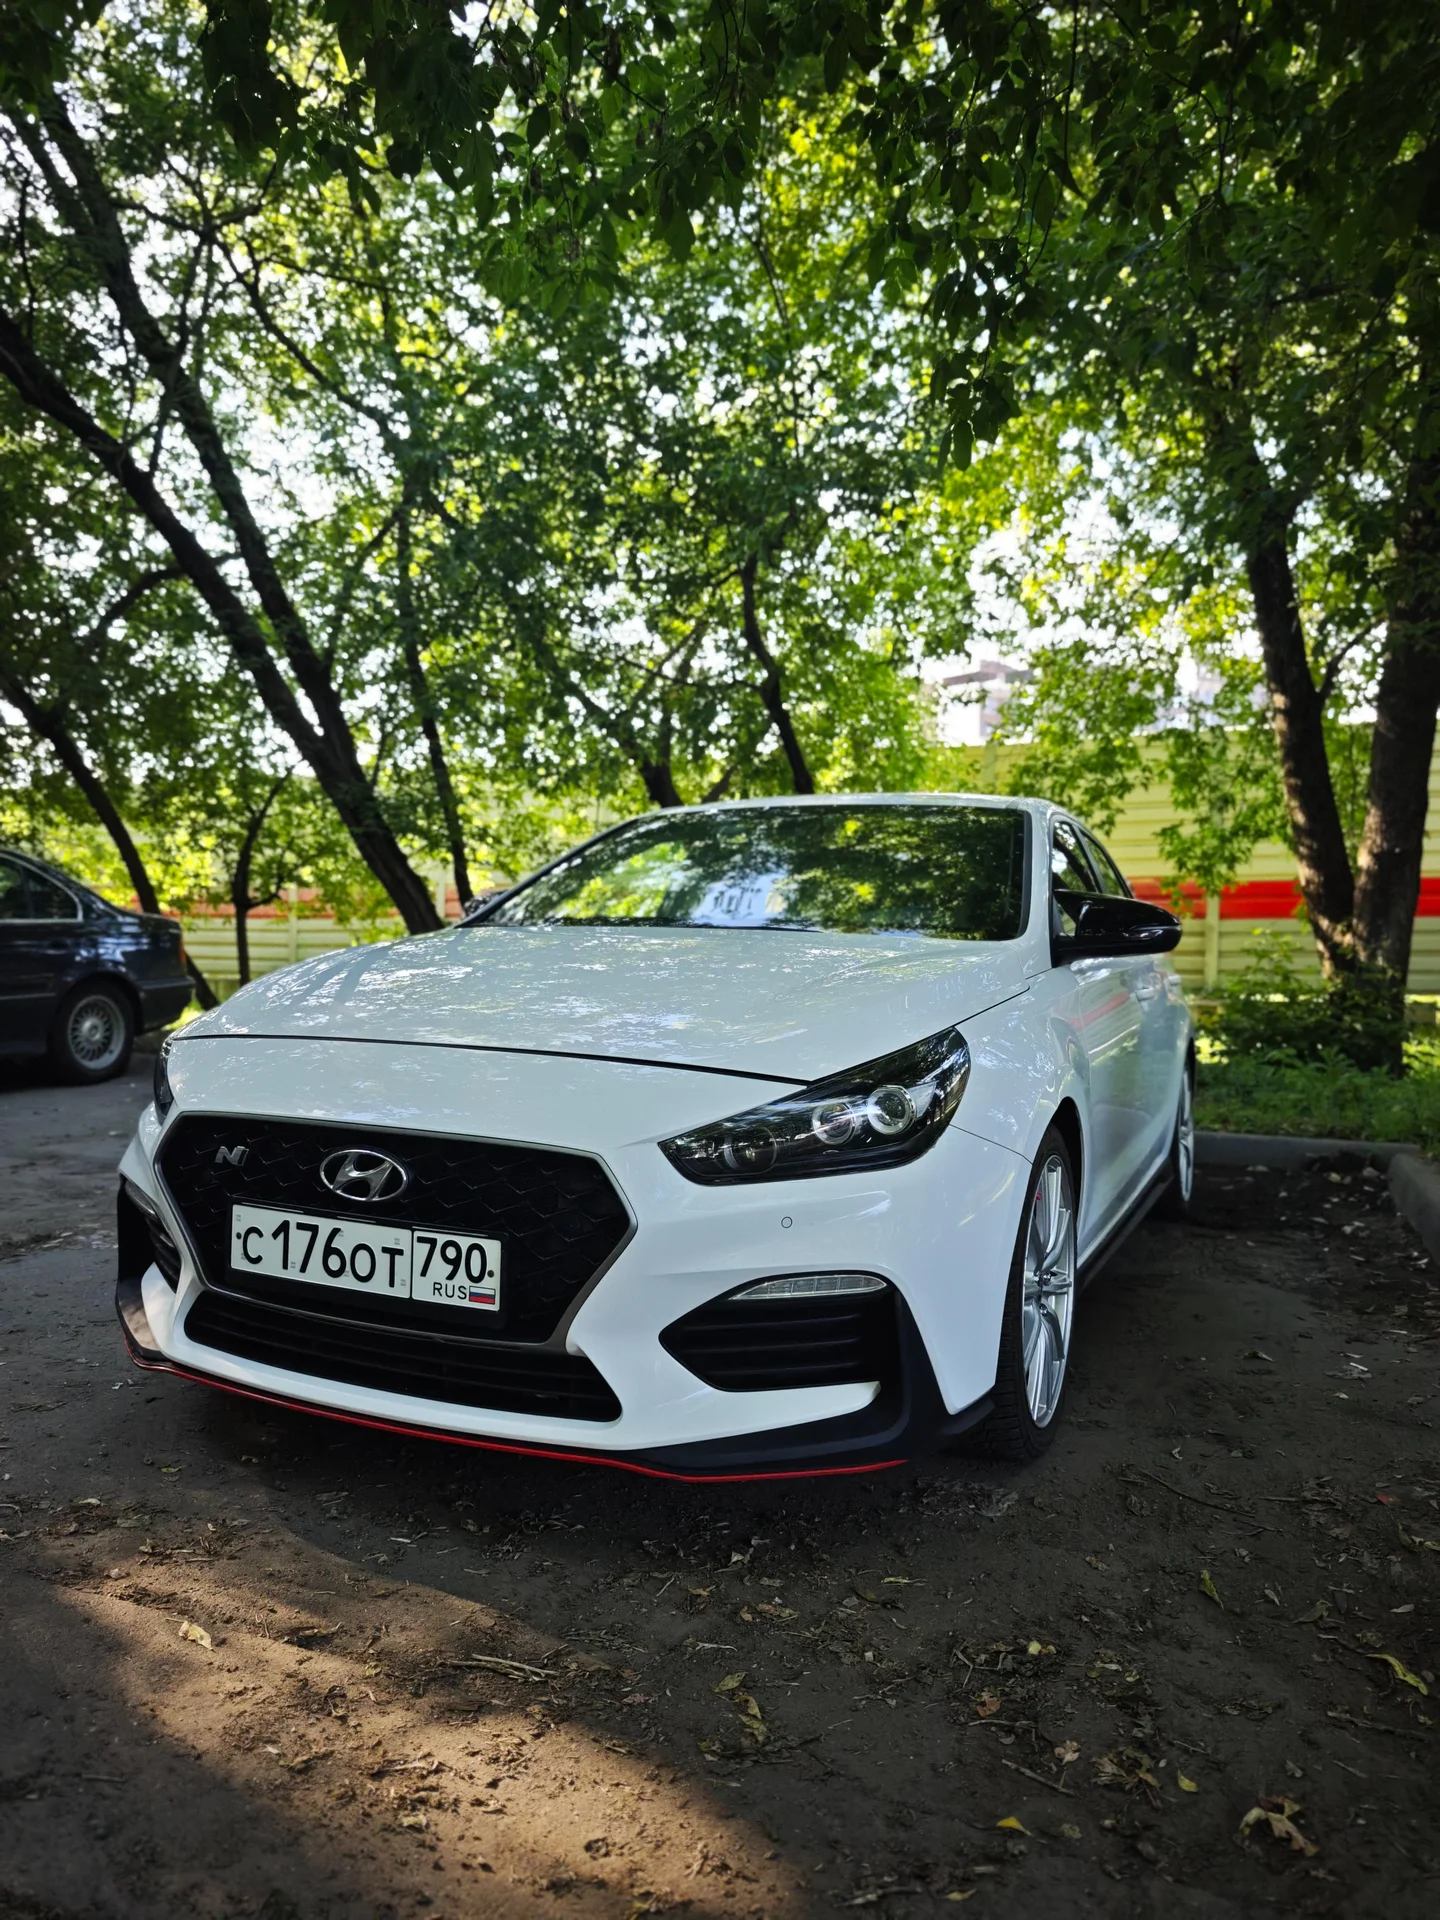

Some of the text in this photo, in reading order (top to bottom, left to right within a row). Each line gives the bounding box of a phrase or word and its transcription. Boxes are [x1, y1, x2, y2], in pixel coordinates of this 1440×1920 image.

[215, 1146, 249, 1166] N
[416, 1236, 488, 1283] 790
[432, 1282, 468, 1300] RUS
